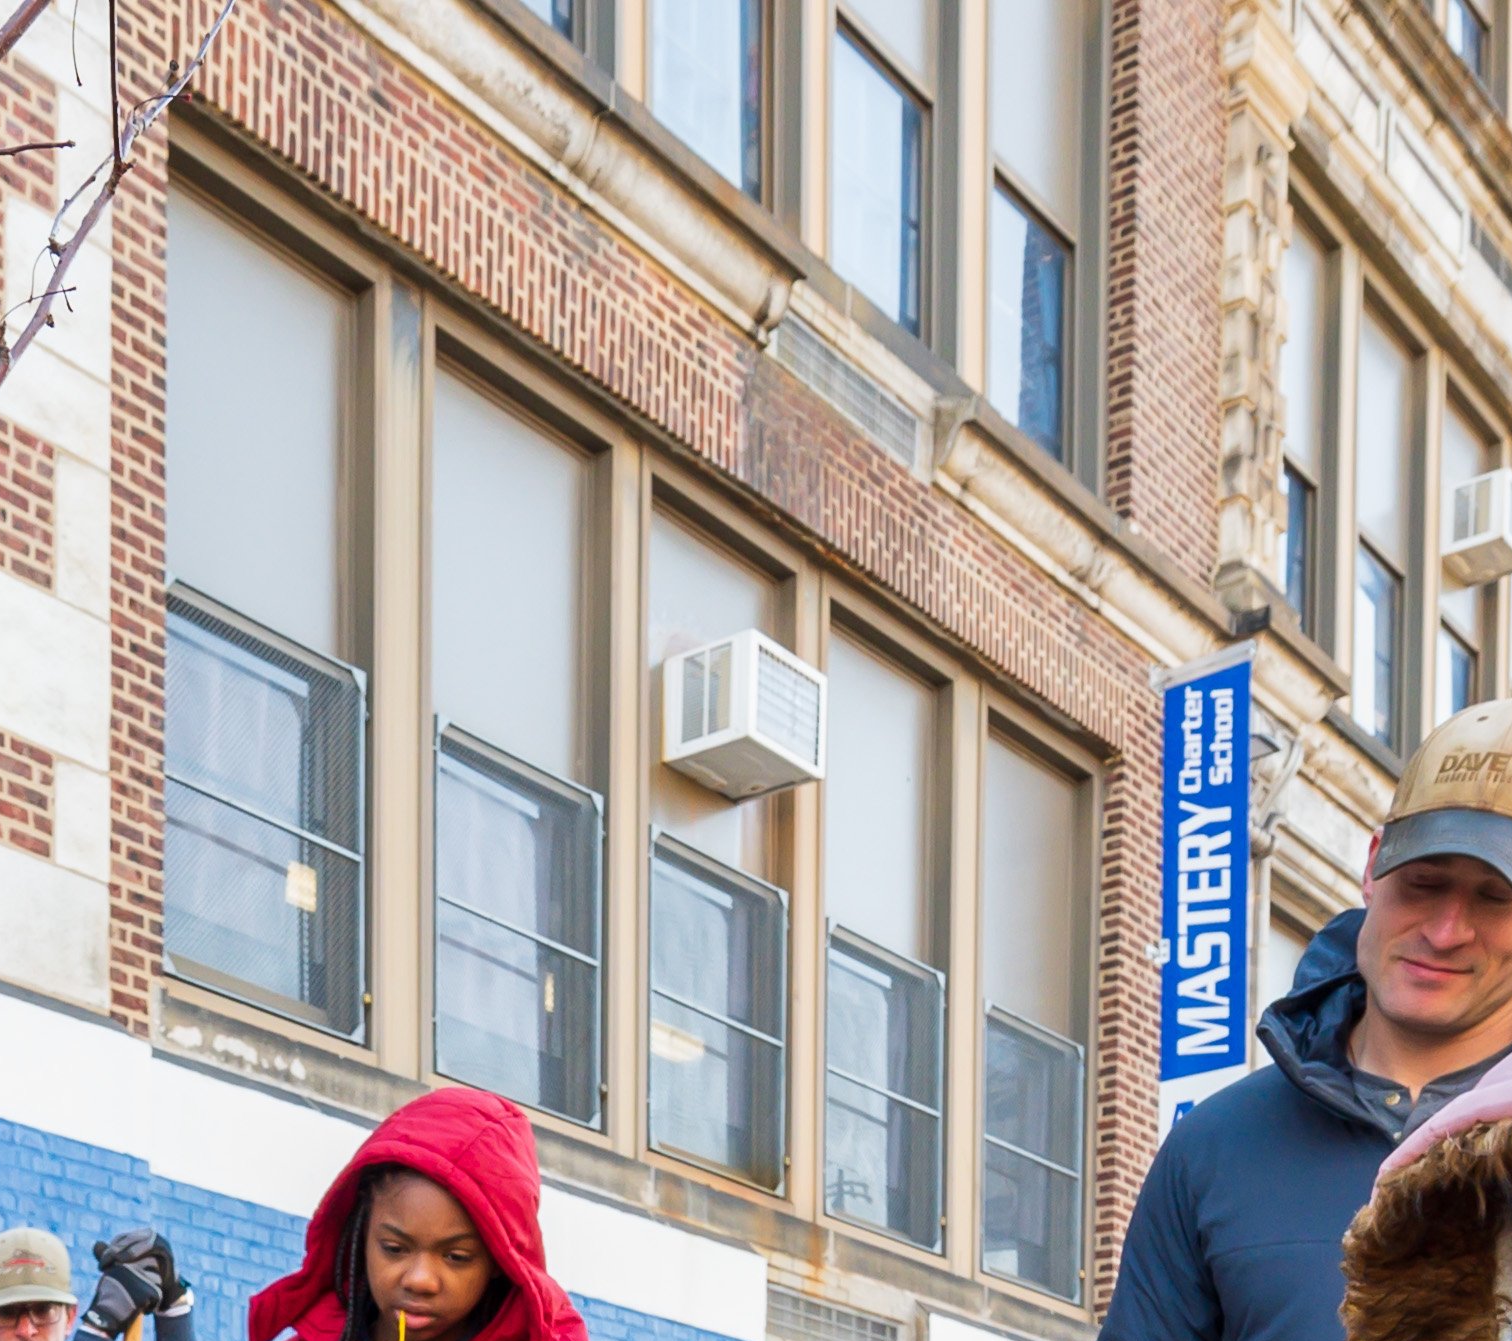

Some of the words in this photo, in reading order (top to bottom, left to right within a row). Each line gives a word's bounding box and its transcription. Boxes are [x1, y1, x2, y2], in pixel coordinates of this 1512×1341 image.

[1178, 685, 1203, 795] Charter
[1208, 688, 1234, 786] School
[1177, 799, 1232, 1057] MASTERY
